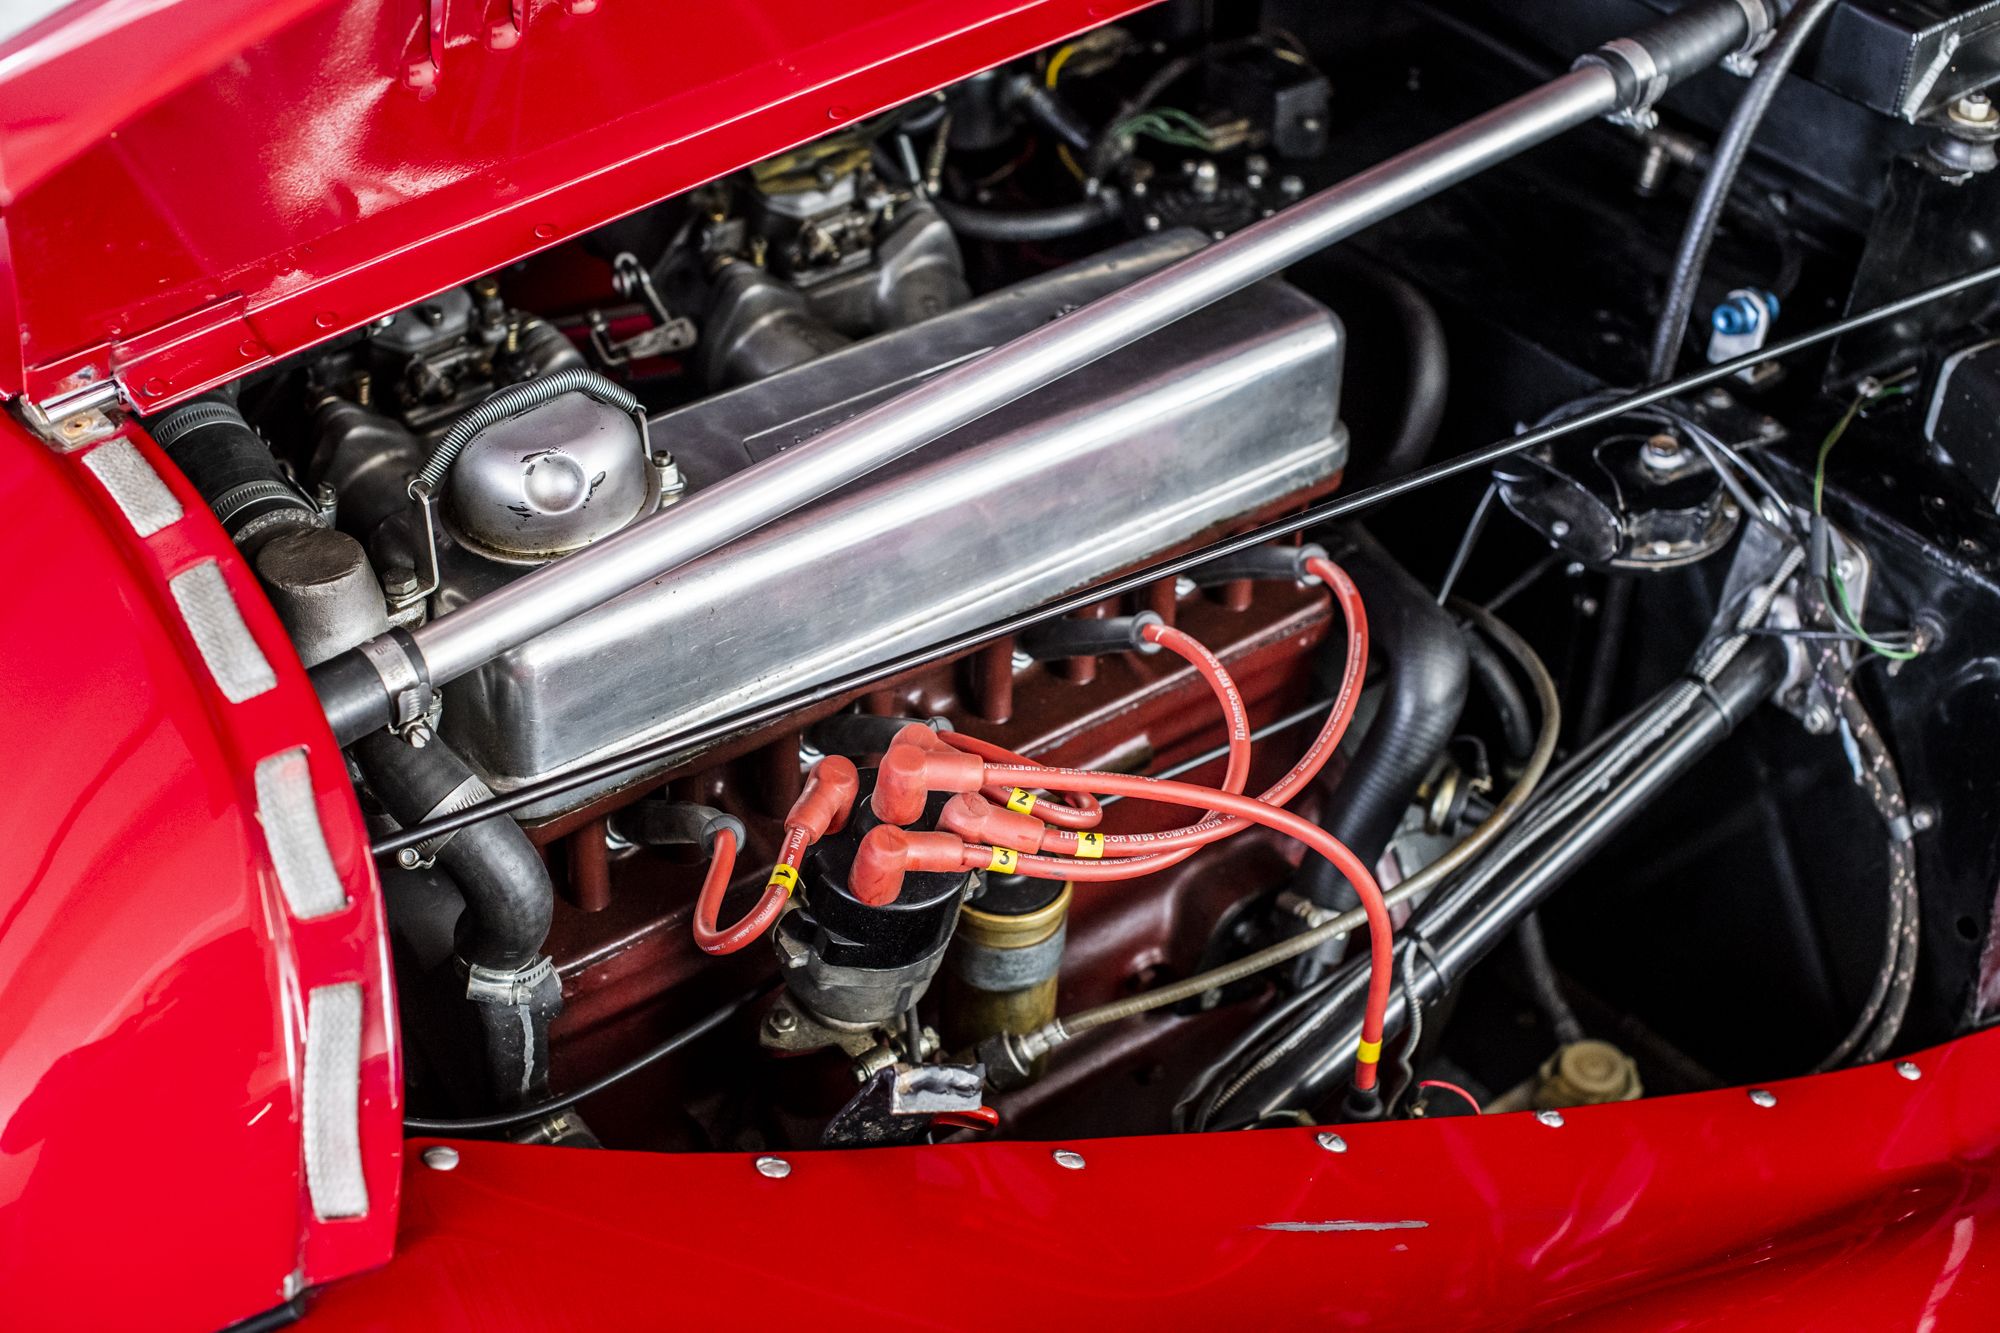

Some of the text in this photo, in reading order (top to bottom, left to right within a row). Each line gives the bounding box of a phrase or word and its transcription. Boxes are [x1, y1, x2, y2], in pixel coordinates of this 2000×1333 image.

[1016, 791, 1029, 806] 2
[1051, 804, 1080, 816] IGNITION
[1128, 833, 1155, 842] KV85
[1157, 819, 1222, 840] COMPETITION
[1084, 833, 1097, 845] 4
[999, 849, 1010, 865] 3
[775, 870, 791, 879] 1
